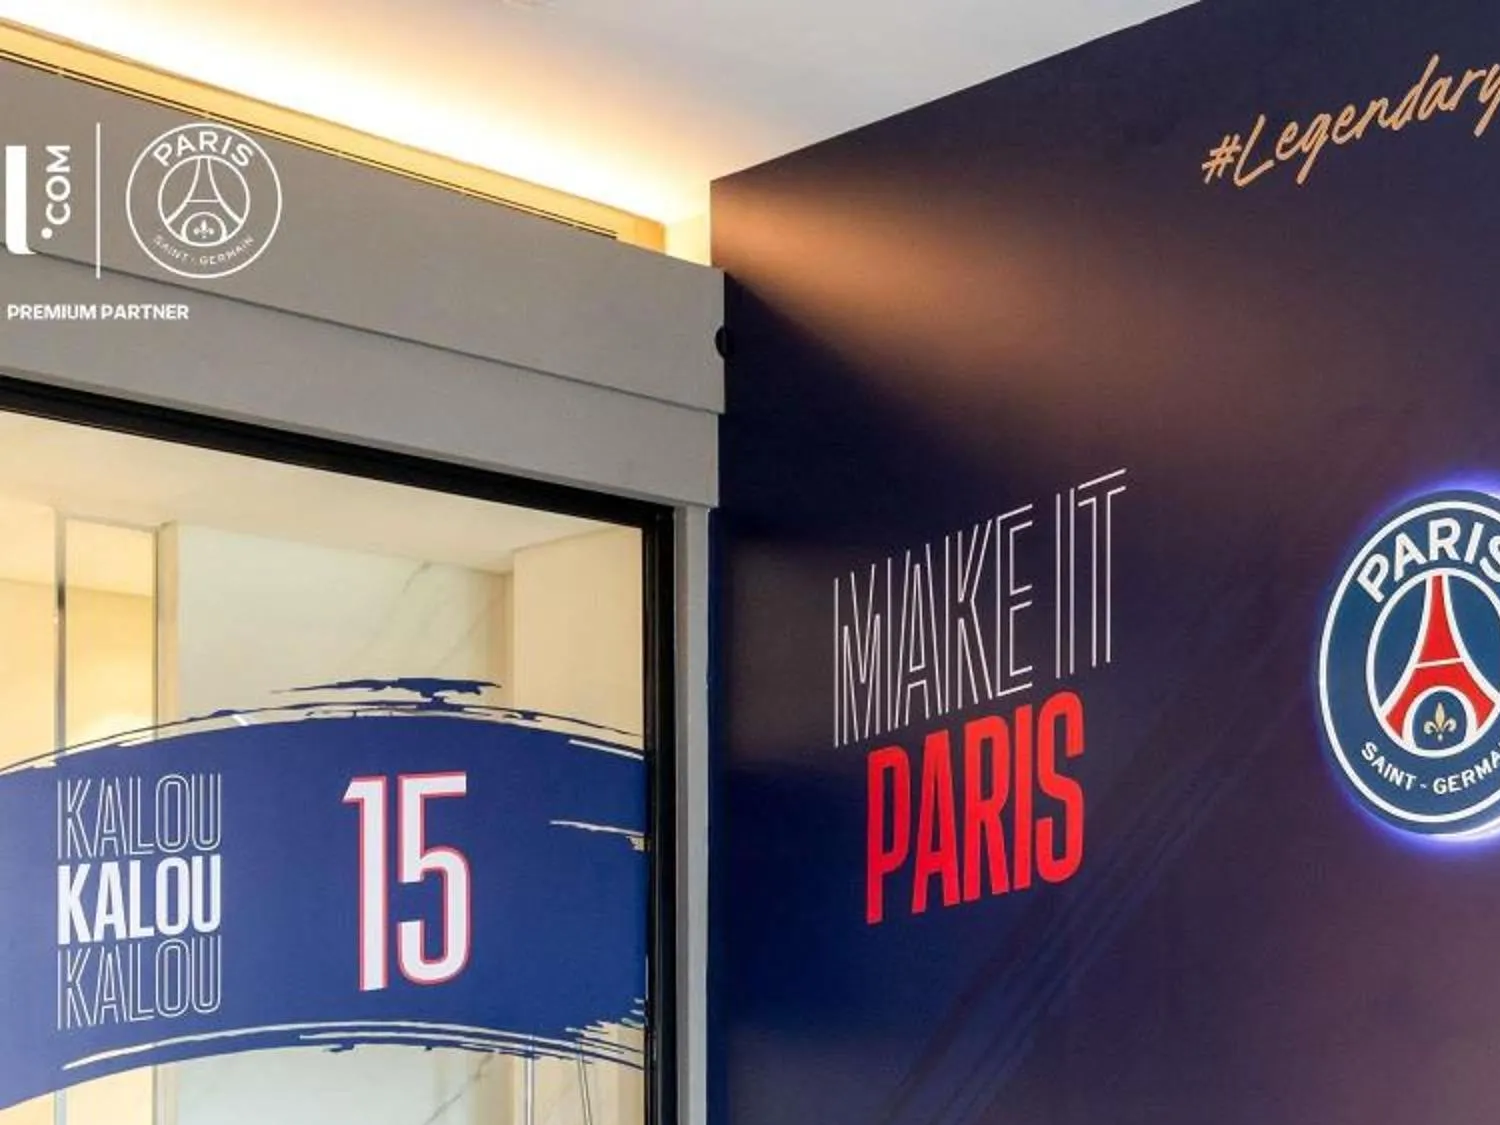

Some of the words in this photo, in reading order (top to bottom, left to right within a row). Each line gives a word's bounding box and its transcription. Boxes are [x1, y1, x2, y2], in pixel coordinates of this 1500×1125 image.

[834, 502, 1033, 749] MAKE
[1054, 468, 1127, 680] IT
[56, 773, 222, 861] KALOU
[342, 770, 472, 993] 15
[865, 691, 1085, 925] PARIS
[57, 855, 222, 946] KALOU
[56, 936, 222, 1031] KALOU
